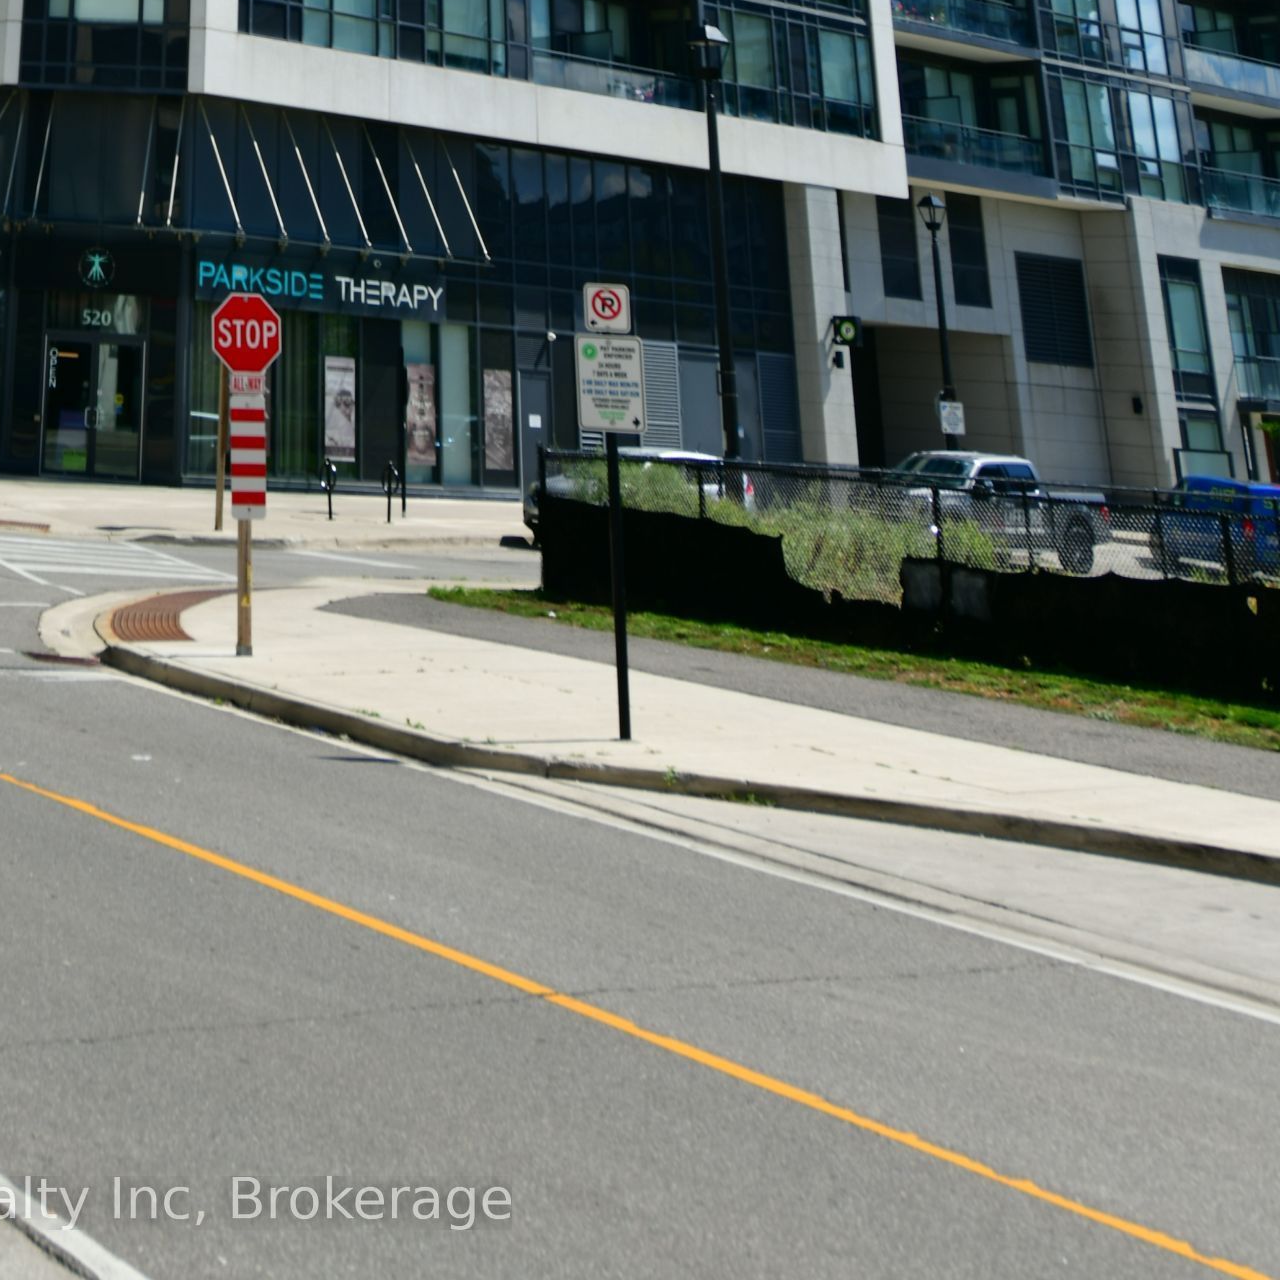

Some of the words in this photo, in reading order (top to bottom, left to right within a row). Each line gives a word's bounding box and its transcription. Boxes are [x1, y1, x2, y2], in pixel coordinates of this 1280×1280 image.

[198, 261, 324, 300] PARKSIDE
[334, 275, 443, 312] THERAPY
[81, 309, 112, 326] 520
[218, 319, 277, 349] STOP
[49, 346, 59, 389] OPEN
